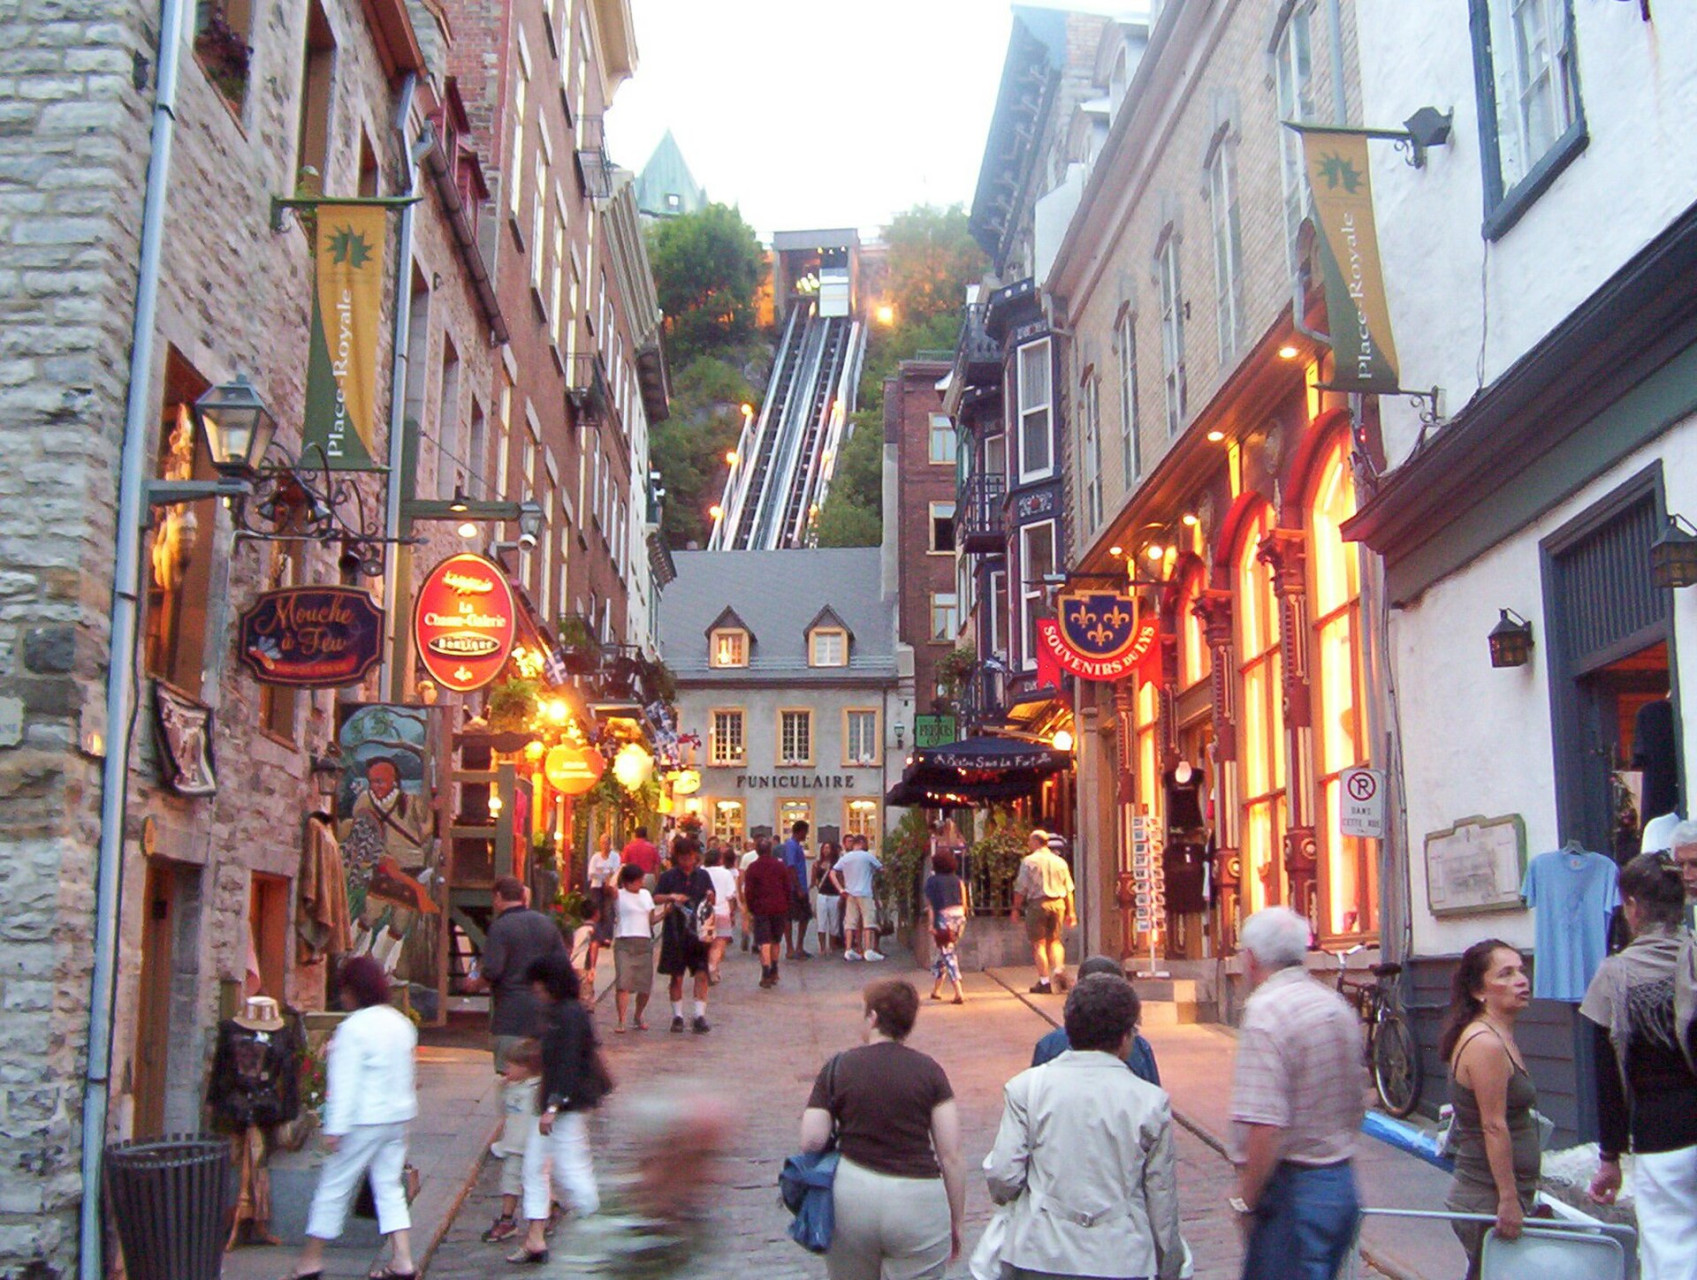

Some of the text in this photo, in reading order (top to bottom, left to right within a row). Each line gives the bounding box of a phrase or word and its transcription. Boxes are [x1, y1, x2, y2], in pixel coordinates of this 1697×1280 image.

[1340, 213, 1373, 379] Place-Royale
[327, 289, 354, 457] Place-Royale
[254, 593, 352, 634] Mouche
[438, 637, 494, 652] Boutique
[1043, 625, 1155, 676] SOUVENIRS DU LYS
[736, 775, 855, 789] FUNICULAIRE
